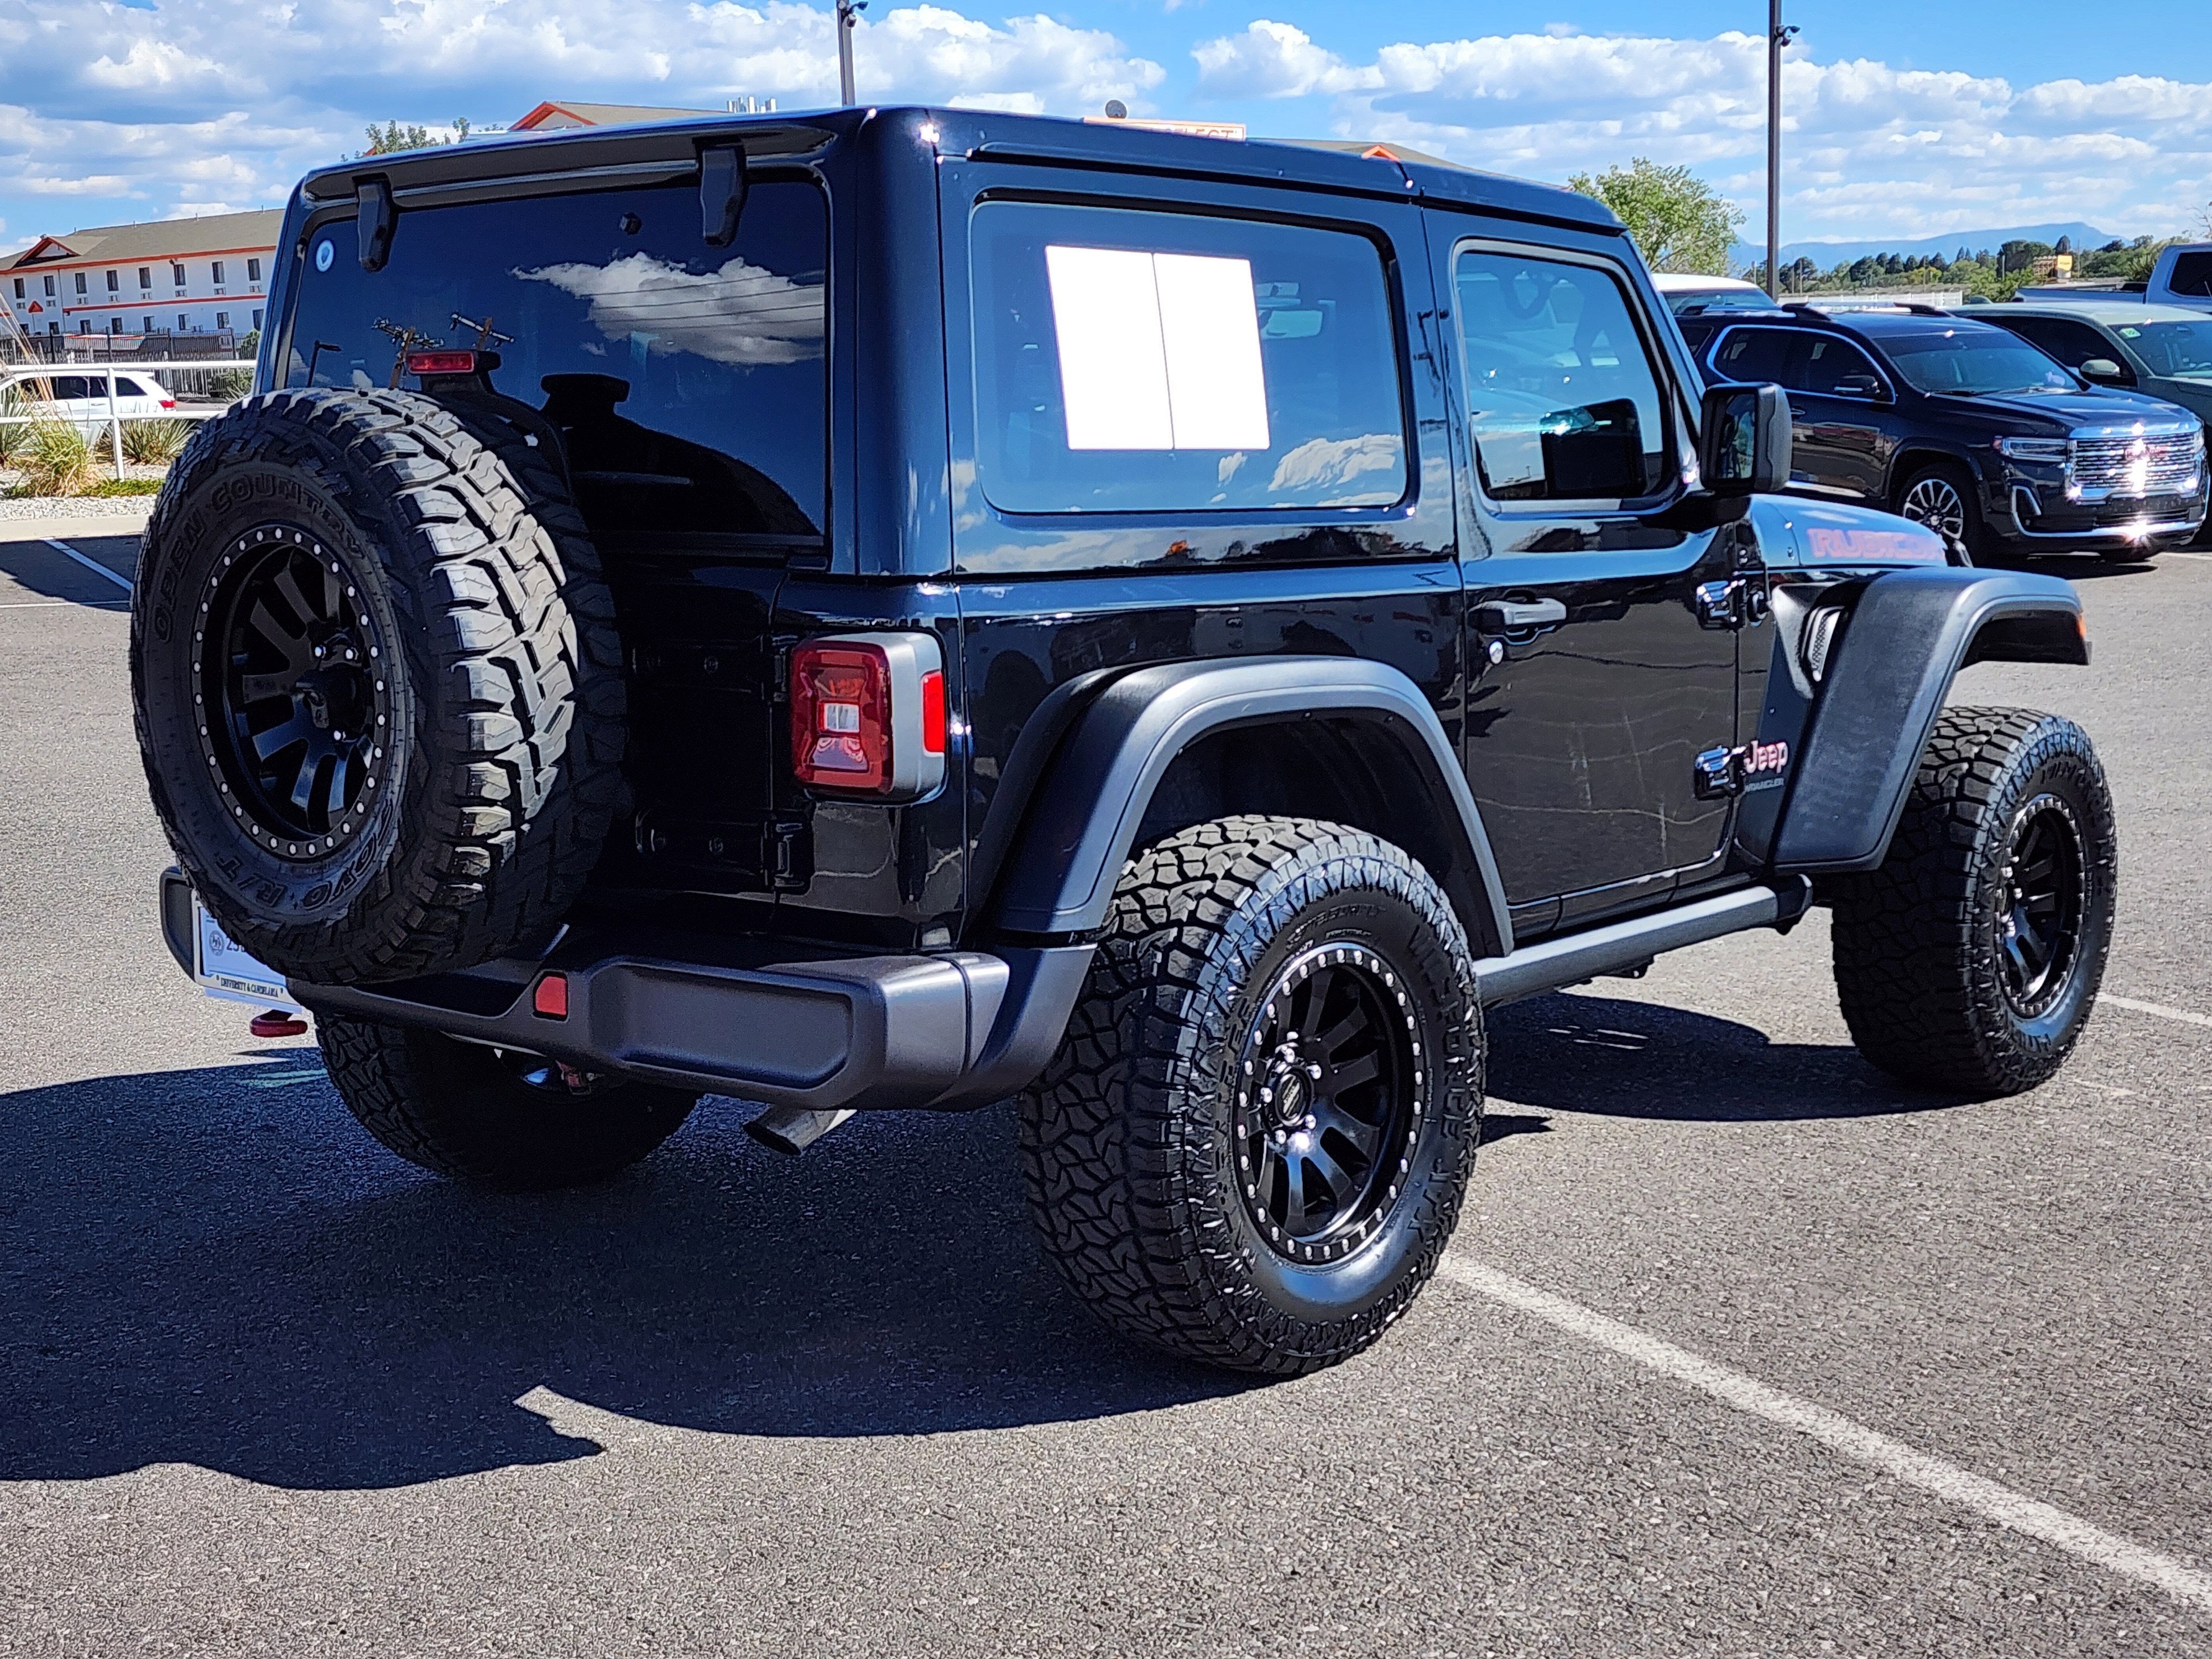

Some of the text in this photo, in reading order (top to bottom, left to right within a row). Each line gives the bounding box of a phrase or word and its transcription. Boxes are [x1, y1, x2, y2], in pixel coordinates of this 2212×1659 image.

[154, 473, 365, 643] OPEN COUNTRY
[1744, 740, 1788, 774] Jeep
[216, 797, 394, 911] TOYO R/T
